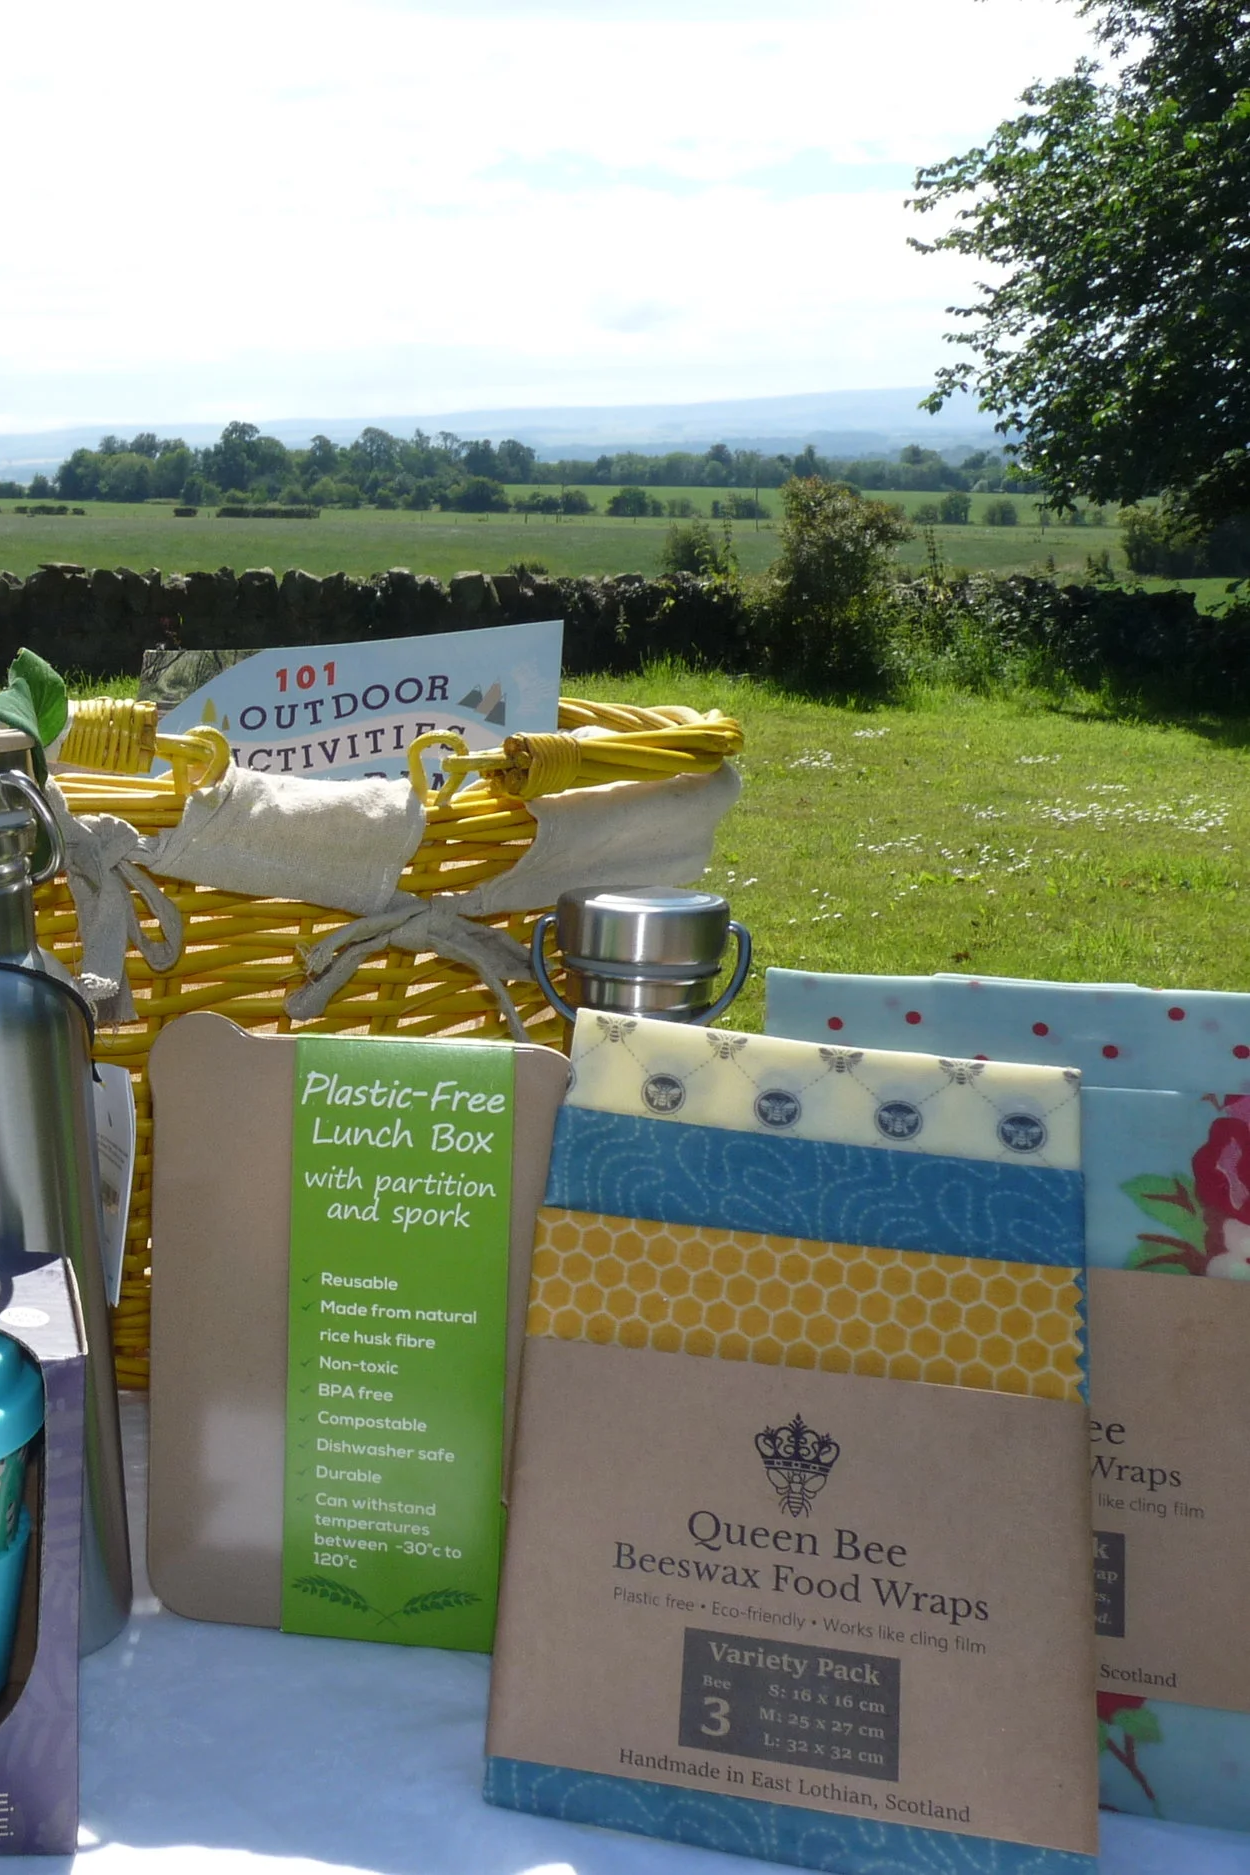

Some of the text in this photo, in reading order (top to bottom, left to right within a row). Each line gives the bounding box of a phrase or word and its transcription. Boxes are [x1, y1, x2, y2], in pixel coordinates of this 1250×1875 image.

[276, 662, 336, 692] 101
[239, 675, 449, 730] OUTDOOR
[301, 1071, 506, 1114] Plastic-Free
[312, 1117, 494, 1154] Lunch Box
[305, 1165, 496, 1200] with partition
[327, 1197, 470, 1233] and spork
[321, 1272, 398, 1291] Reusable
[320, 1300, 477, 1324] Made from natural
[319, 1329, 436, 1349] rice husk fibre
[319, 1356, 399, 1375] Non-toxic
[318, 1383, 393, 1402] BPA free
[317, 1411, 427, 1432] Compostable
[316, 1438, 455, 1462] Dishwasher safe
[316, 1465, 382, 1484] Durable
[315, 1492, 436, 1516] Can withstand
[1097, 1493, 1205, 1519] like cling film
[314, 1513, 430, 1536] temperatures
[687, 1510, 908, 1568] Queen Bee
[314, 1532, 388, 1552] between
[444, 1545, 462, 1559] to
[612, 1541, 990, 1626] Beeswax Food Wraps
[612, 1586, 986, 1654] Plastic free Eco-friendly Works like cling film
[708, 1641, 880, 1686] Variety Pack
[1100, 1663, 1177, 1688] Scotland
[702, 1675, 732, 1690] Bee
[768, 1684, 886, 1714] S: 16 x 16 cm
[700, 1696, 731, 1737] 3
[759, 1707, 885, 1740] M: 25 x 27 cm
[763, 1732, 884, 1765] L: 32 x 32 cm
[619, 1748, 970, 1822] Handmade in East Lothian, Scotland
